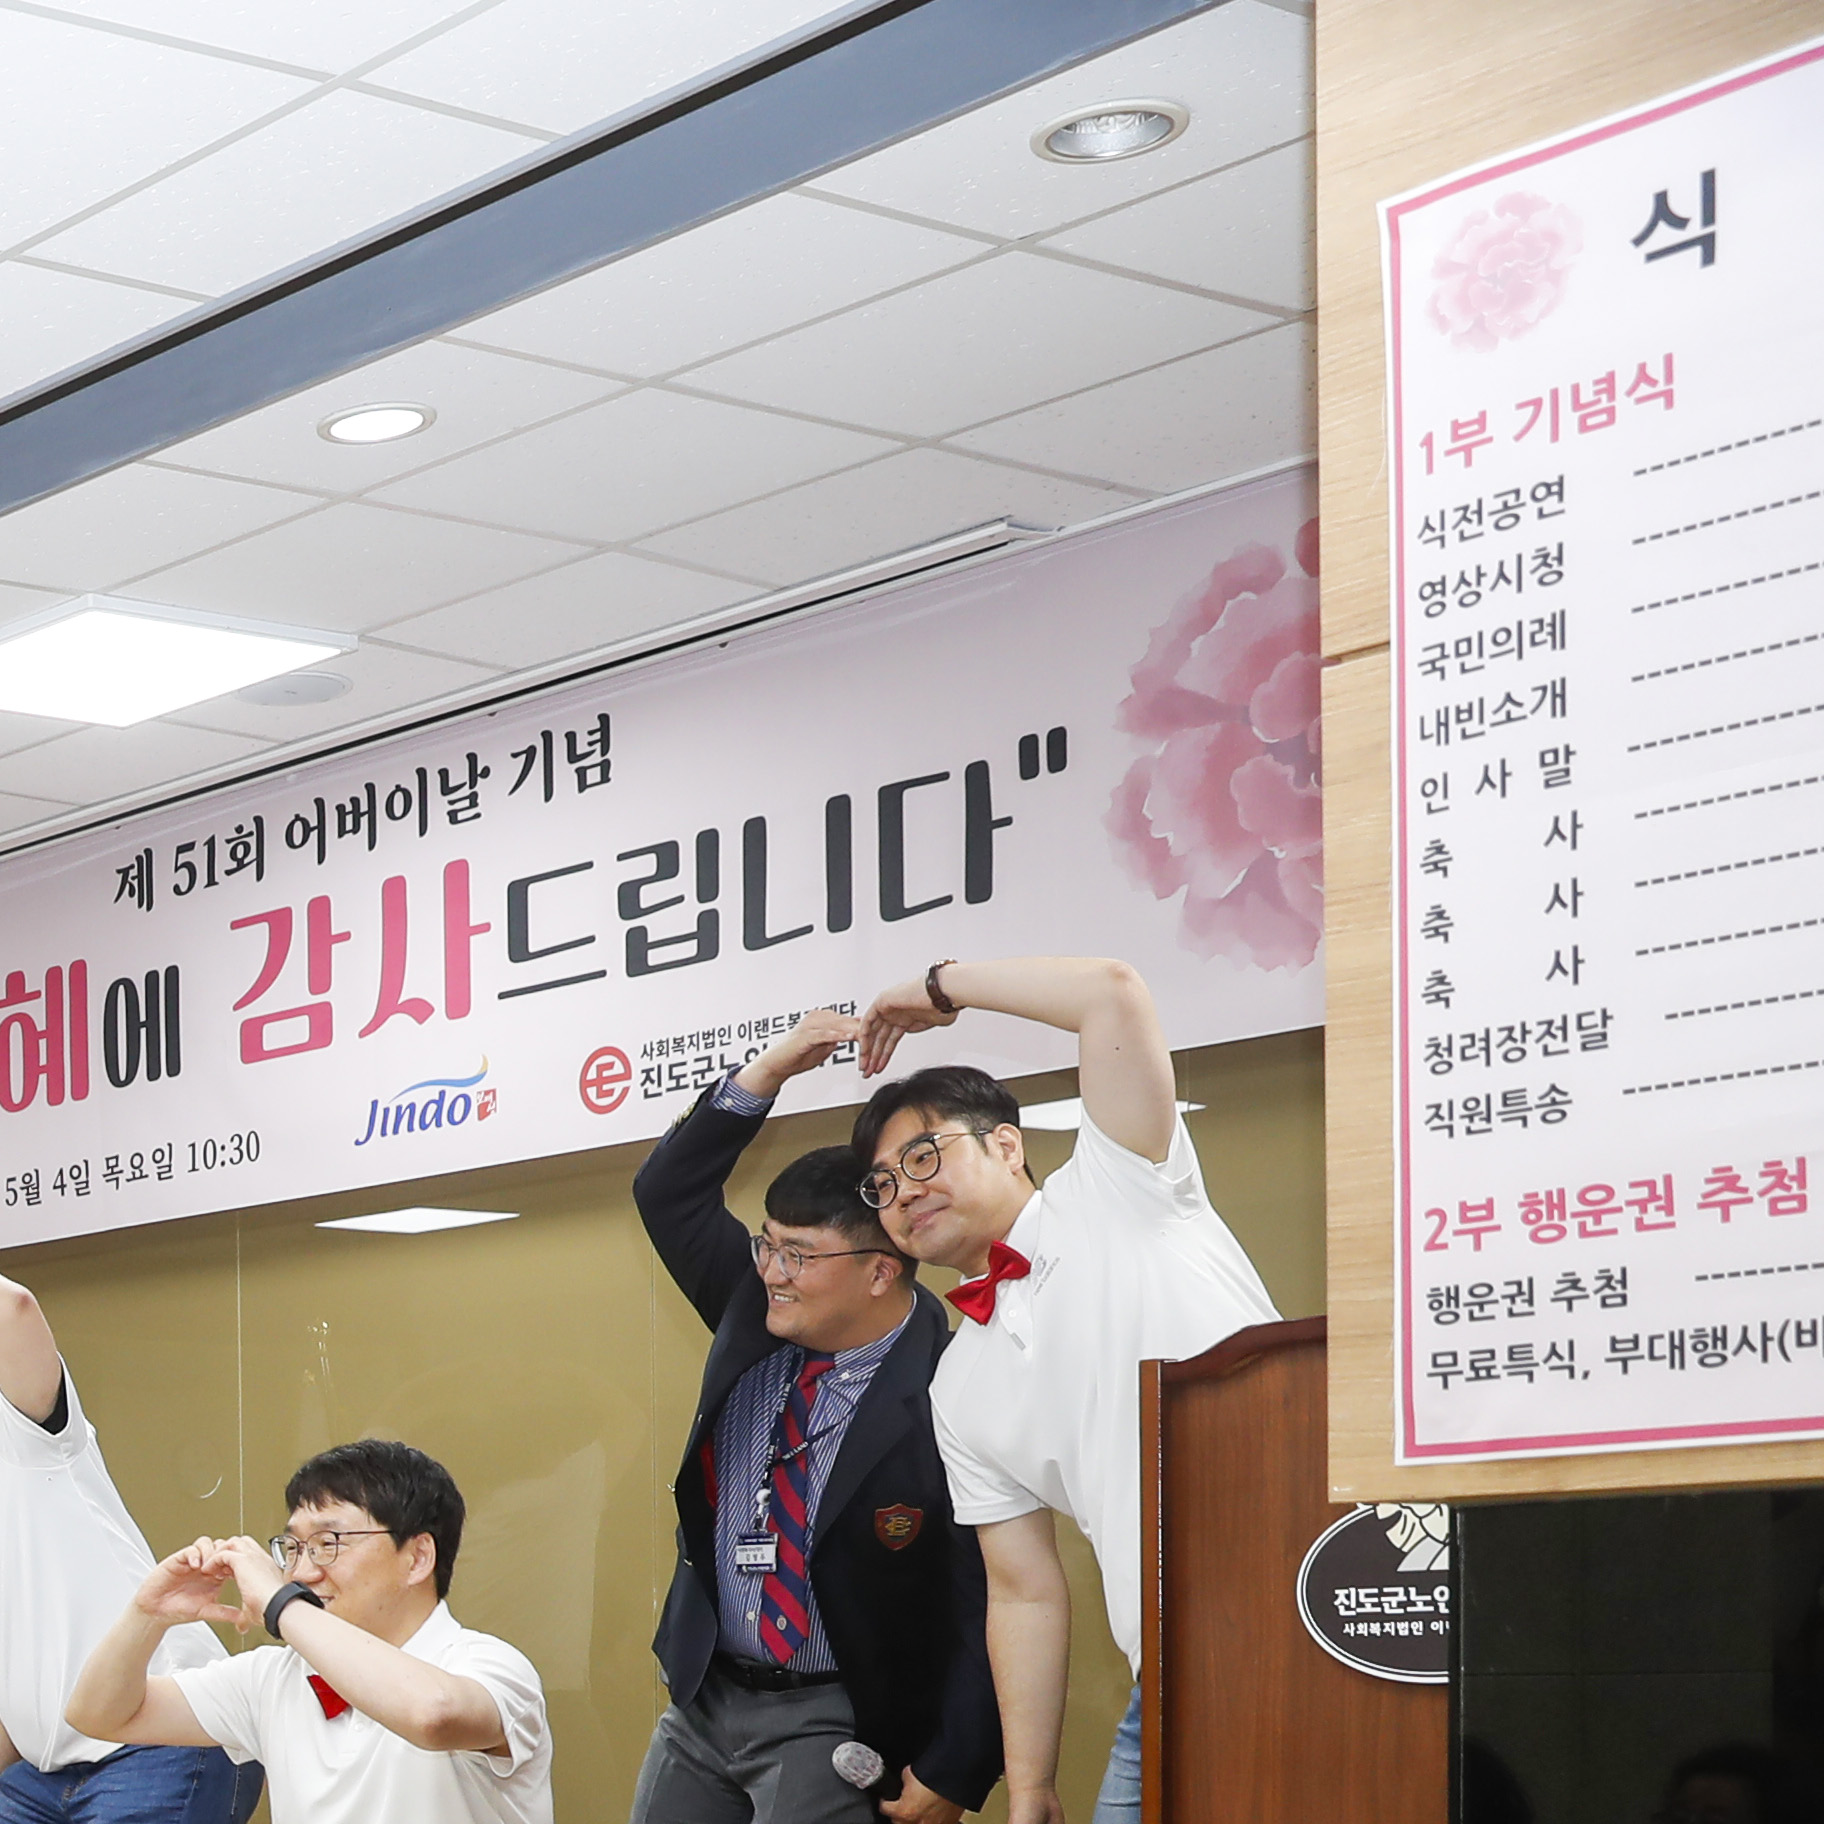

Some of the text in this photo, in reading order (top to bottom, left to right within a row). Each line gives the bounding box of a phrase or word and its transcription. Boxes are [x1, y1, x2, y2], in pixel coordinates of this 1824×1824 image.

[1630, 167, 1719, 268] 식
[1418, 352, 1678, 476] 1부 기념식
[1416, 474, 1567, 550] 식전공연
[1417, 542, 1566, 619] 영상시청
[1417, 609, 1567, 682] 국민의례
[1418, 677, 1568, 748] 내빈소개
[113, 712, 614, 912] 제 51회 어버이날 기념
[1419, 809, 1584, 882] 축 사
[1420, 877, 1584, 946] 축 사
[1420, 944, 1586, 1011] 축 사
[640, 1000, 857, 1061] 사회복지법인 이랜드복단
[1423, 1007, 1614, 1076] 청려장전달
[354, 1089, 472, 1146] Jindo
[1423, 1082, 1574, 1139] 직원특송
[5, 1168, 43, 1208] 5월
[52, 1159, 92, 1198] 4일
[102, 1142, 174, 1191] 목요일
[187, 1130, 261, 1173] 10:30
[1423, 1156, 1810, 1254] 2부 행운권 추첨
[1426, 1266, 1630, 1327] 행운권 추첨
[1426, 1338, 1593, 1392] 무료특식,
[1343, 1621, 1450, 1637] 사회복지법인 이
